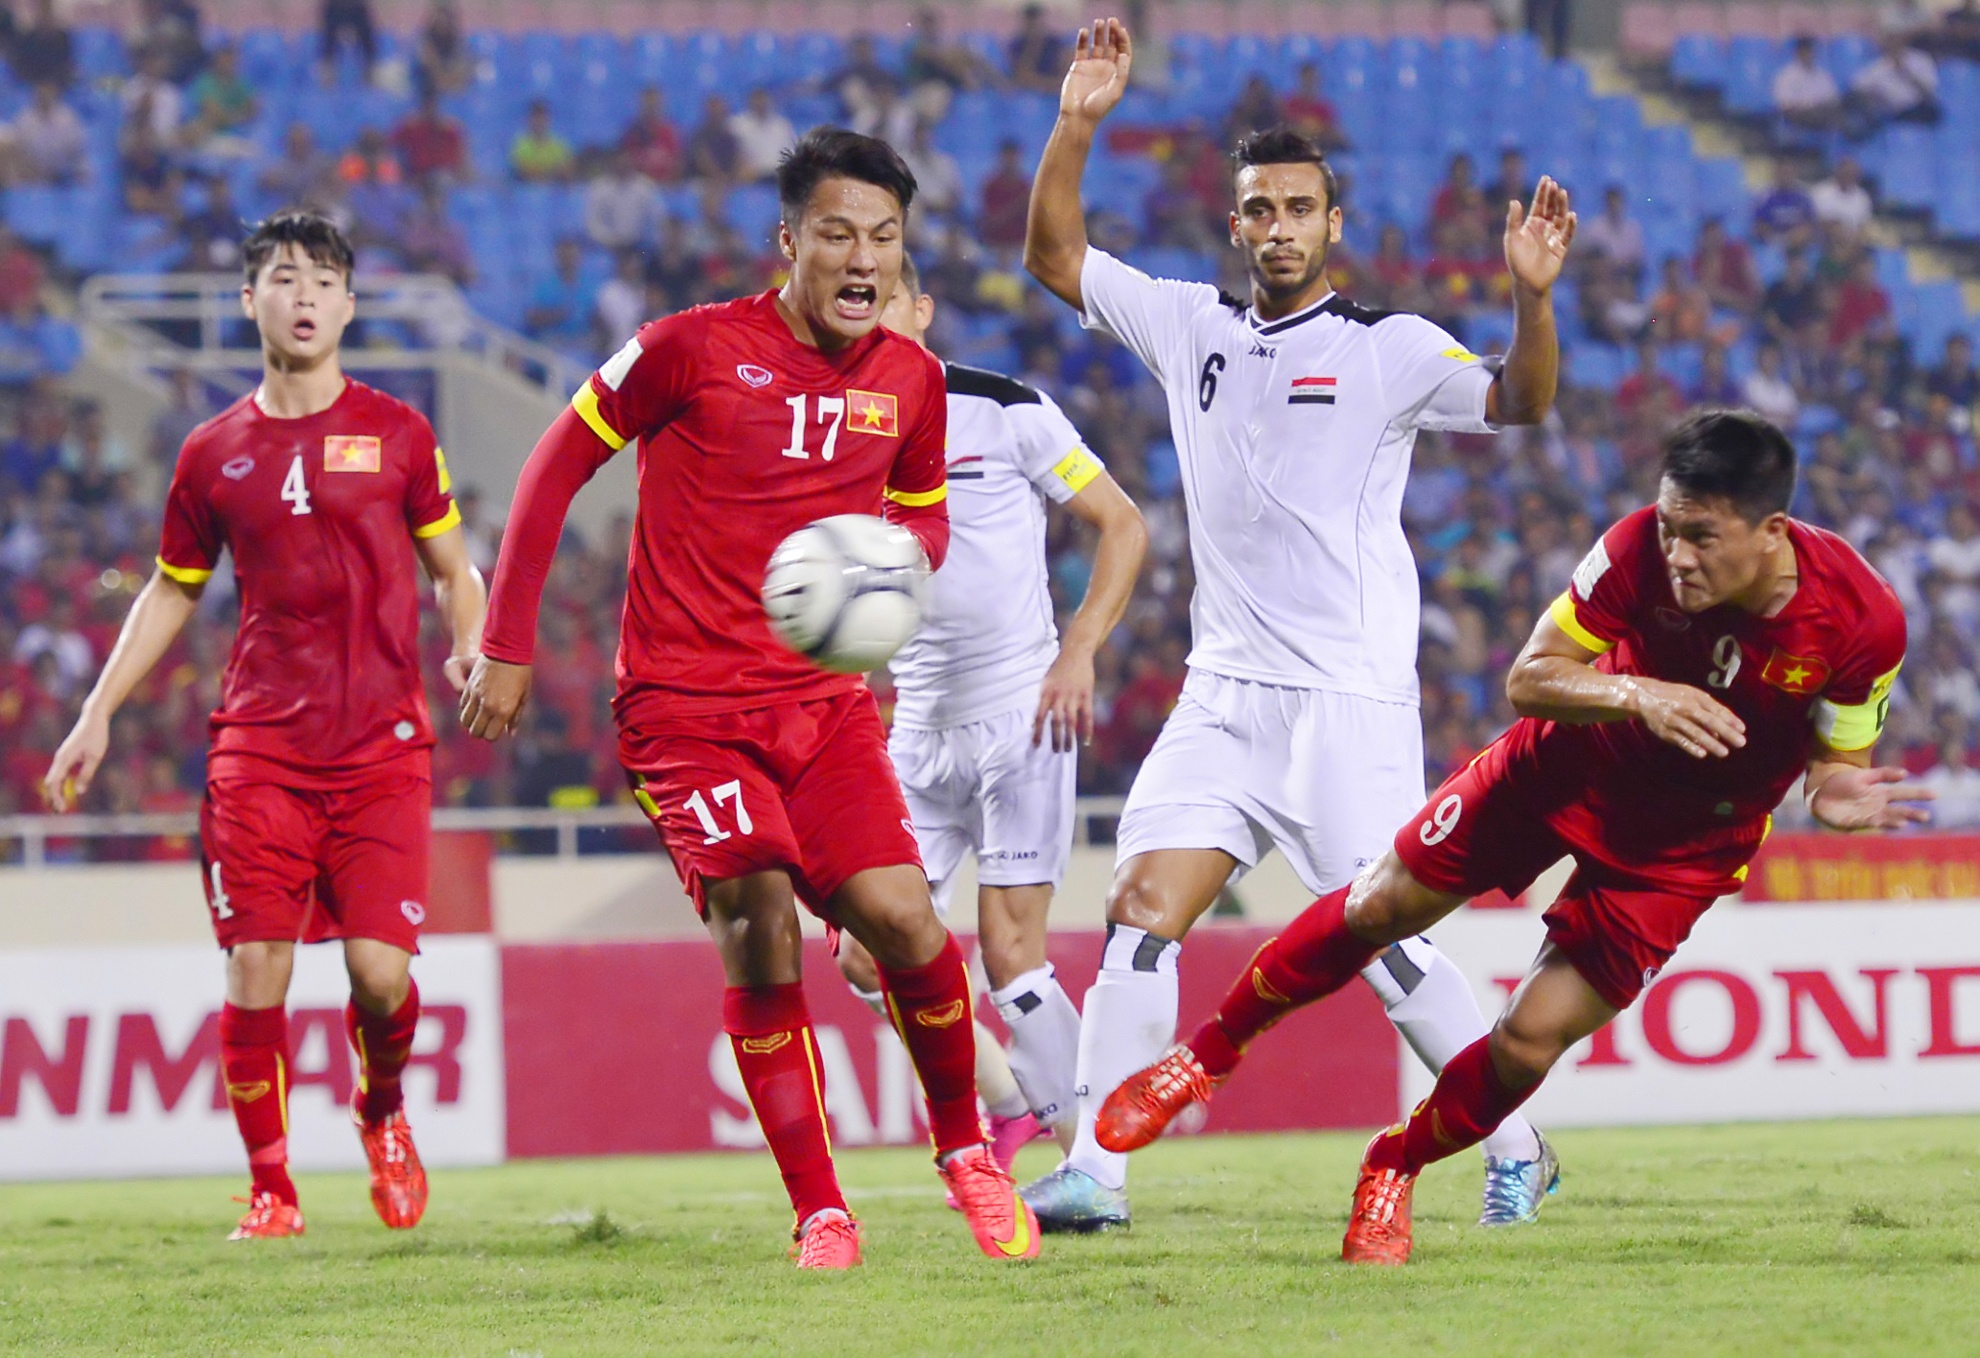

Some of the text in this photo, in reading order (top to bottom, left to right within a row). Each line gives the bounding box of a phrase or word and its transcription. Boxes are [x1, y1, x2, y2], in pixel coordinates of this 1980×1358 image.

[1248, 345, 1277, 359] JAKO
[1199, 352, 1226, 413] 6
[781, 393, 845, 461] 17
[281, 455, 312, 515] 4
[1707, 634, 1742, 688] 9
[683, 779, 753, 845] 17
[1419, 794, 1463, 846] 9
[1011, 851, 1038, 860] JAKO
[211, 860, 234, 920] 4
